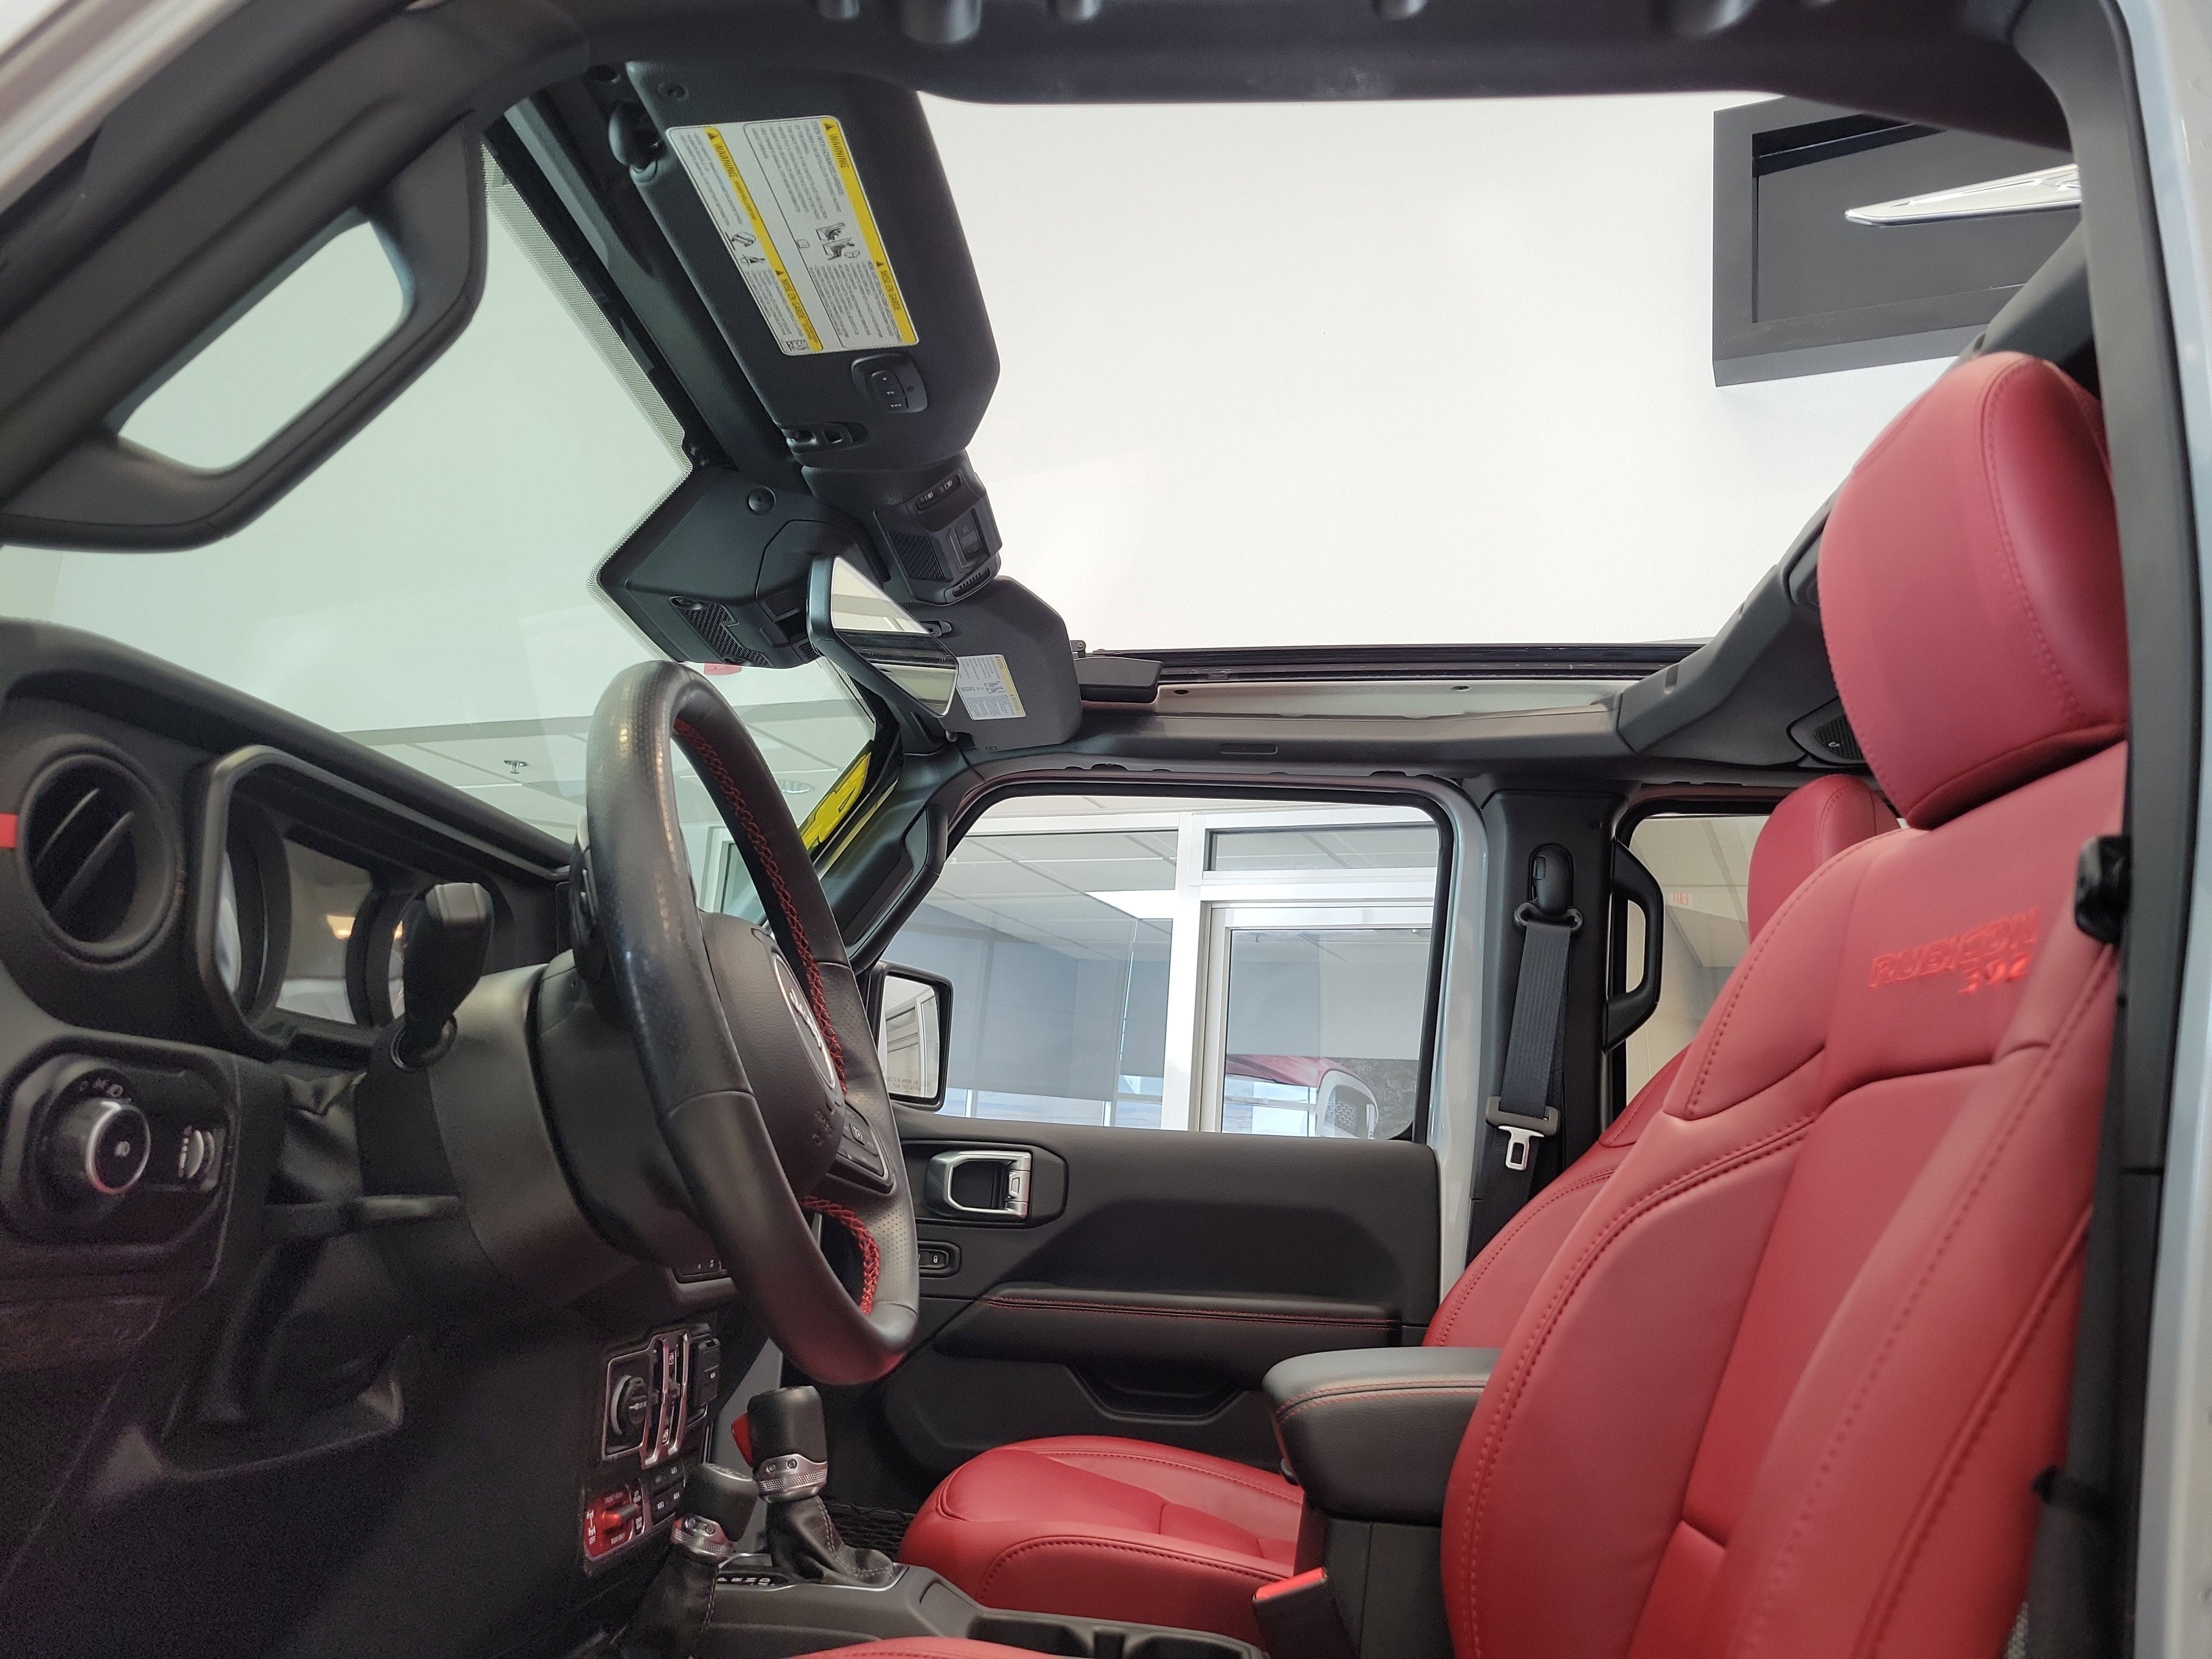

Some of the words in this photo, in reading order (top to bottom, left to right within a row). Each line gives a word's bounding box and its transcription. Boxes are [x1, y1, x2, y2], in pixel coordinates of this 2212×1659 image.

[713, 143, 738, 177] WARNING
[828, 134, 850, 168] WARNING
[1867, 906, 2043, 989] RUBICON
